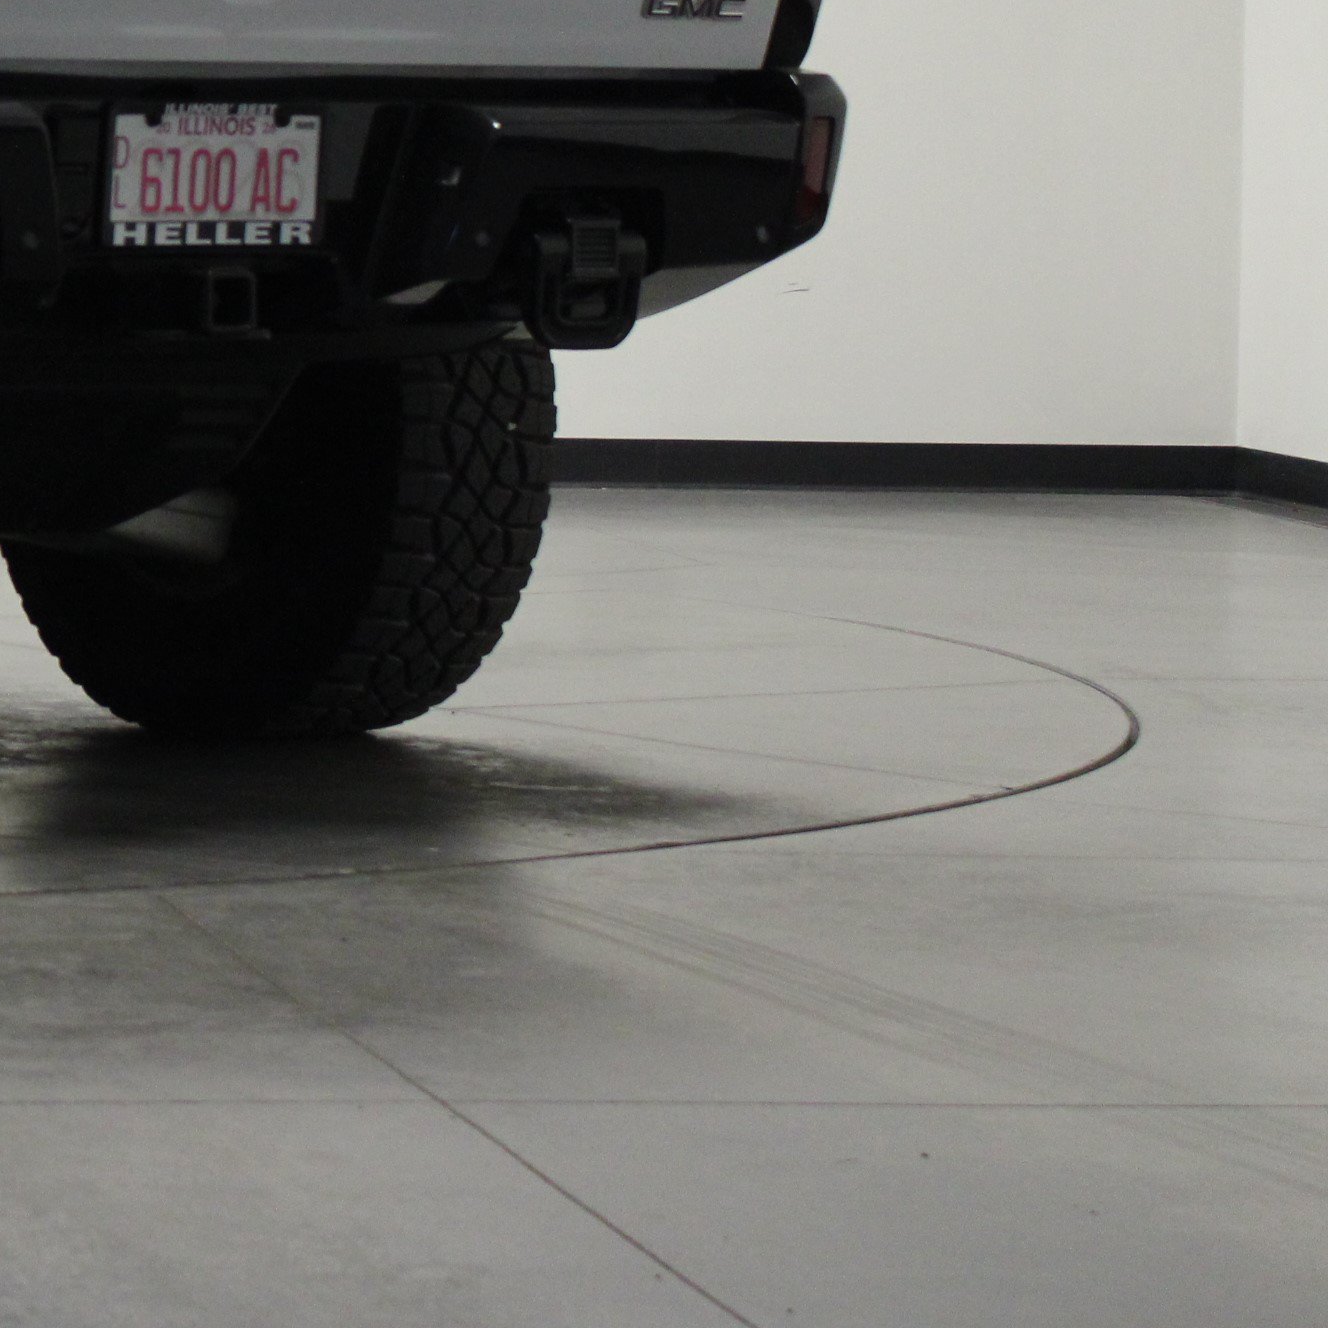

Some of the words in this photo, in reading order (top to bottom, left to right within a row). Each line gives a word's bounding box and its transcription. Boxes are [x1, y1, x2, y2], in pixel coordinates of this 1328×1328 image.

[177, 115, 257, 136] ILLINOIS
[140, 147, 237, 214] 6100
[250, 147, 301, 213] AC
[112, 222, 312, 247] HELLER
